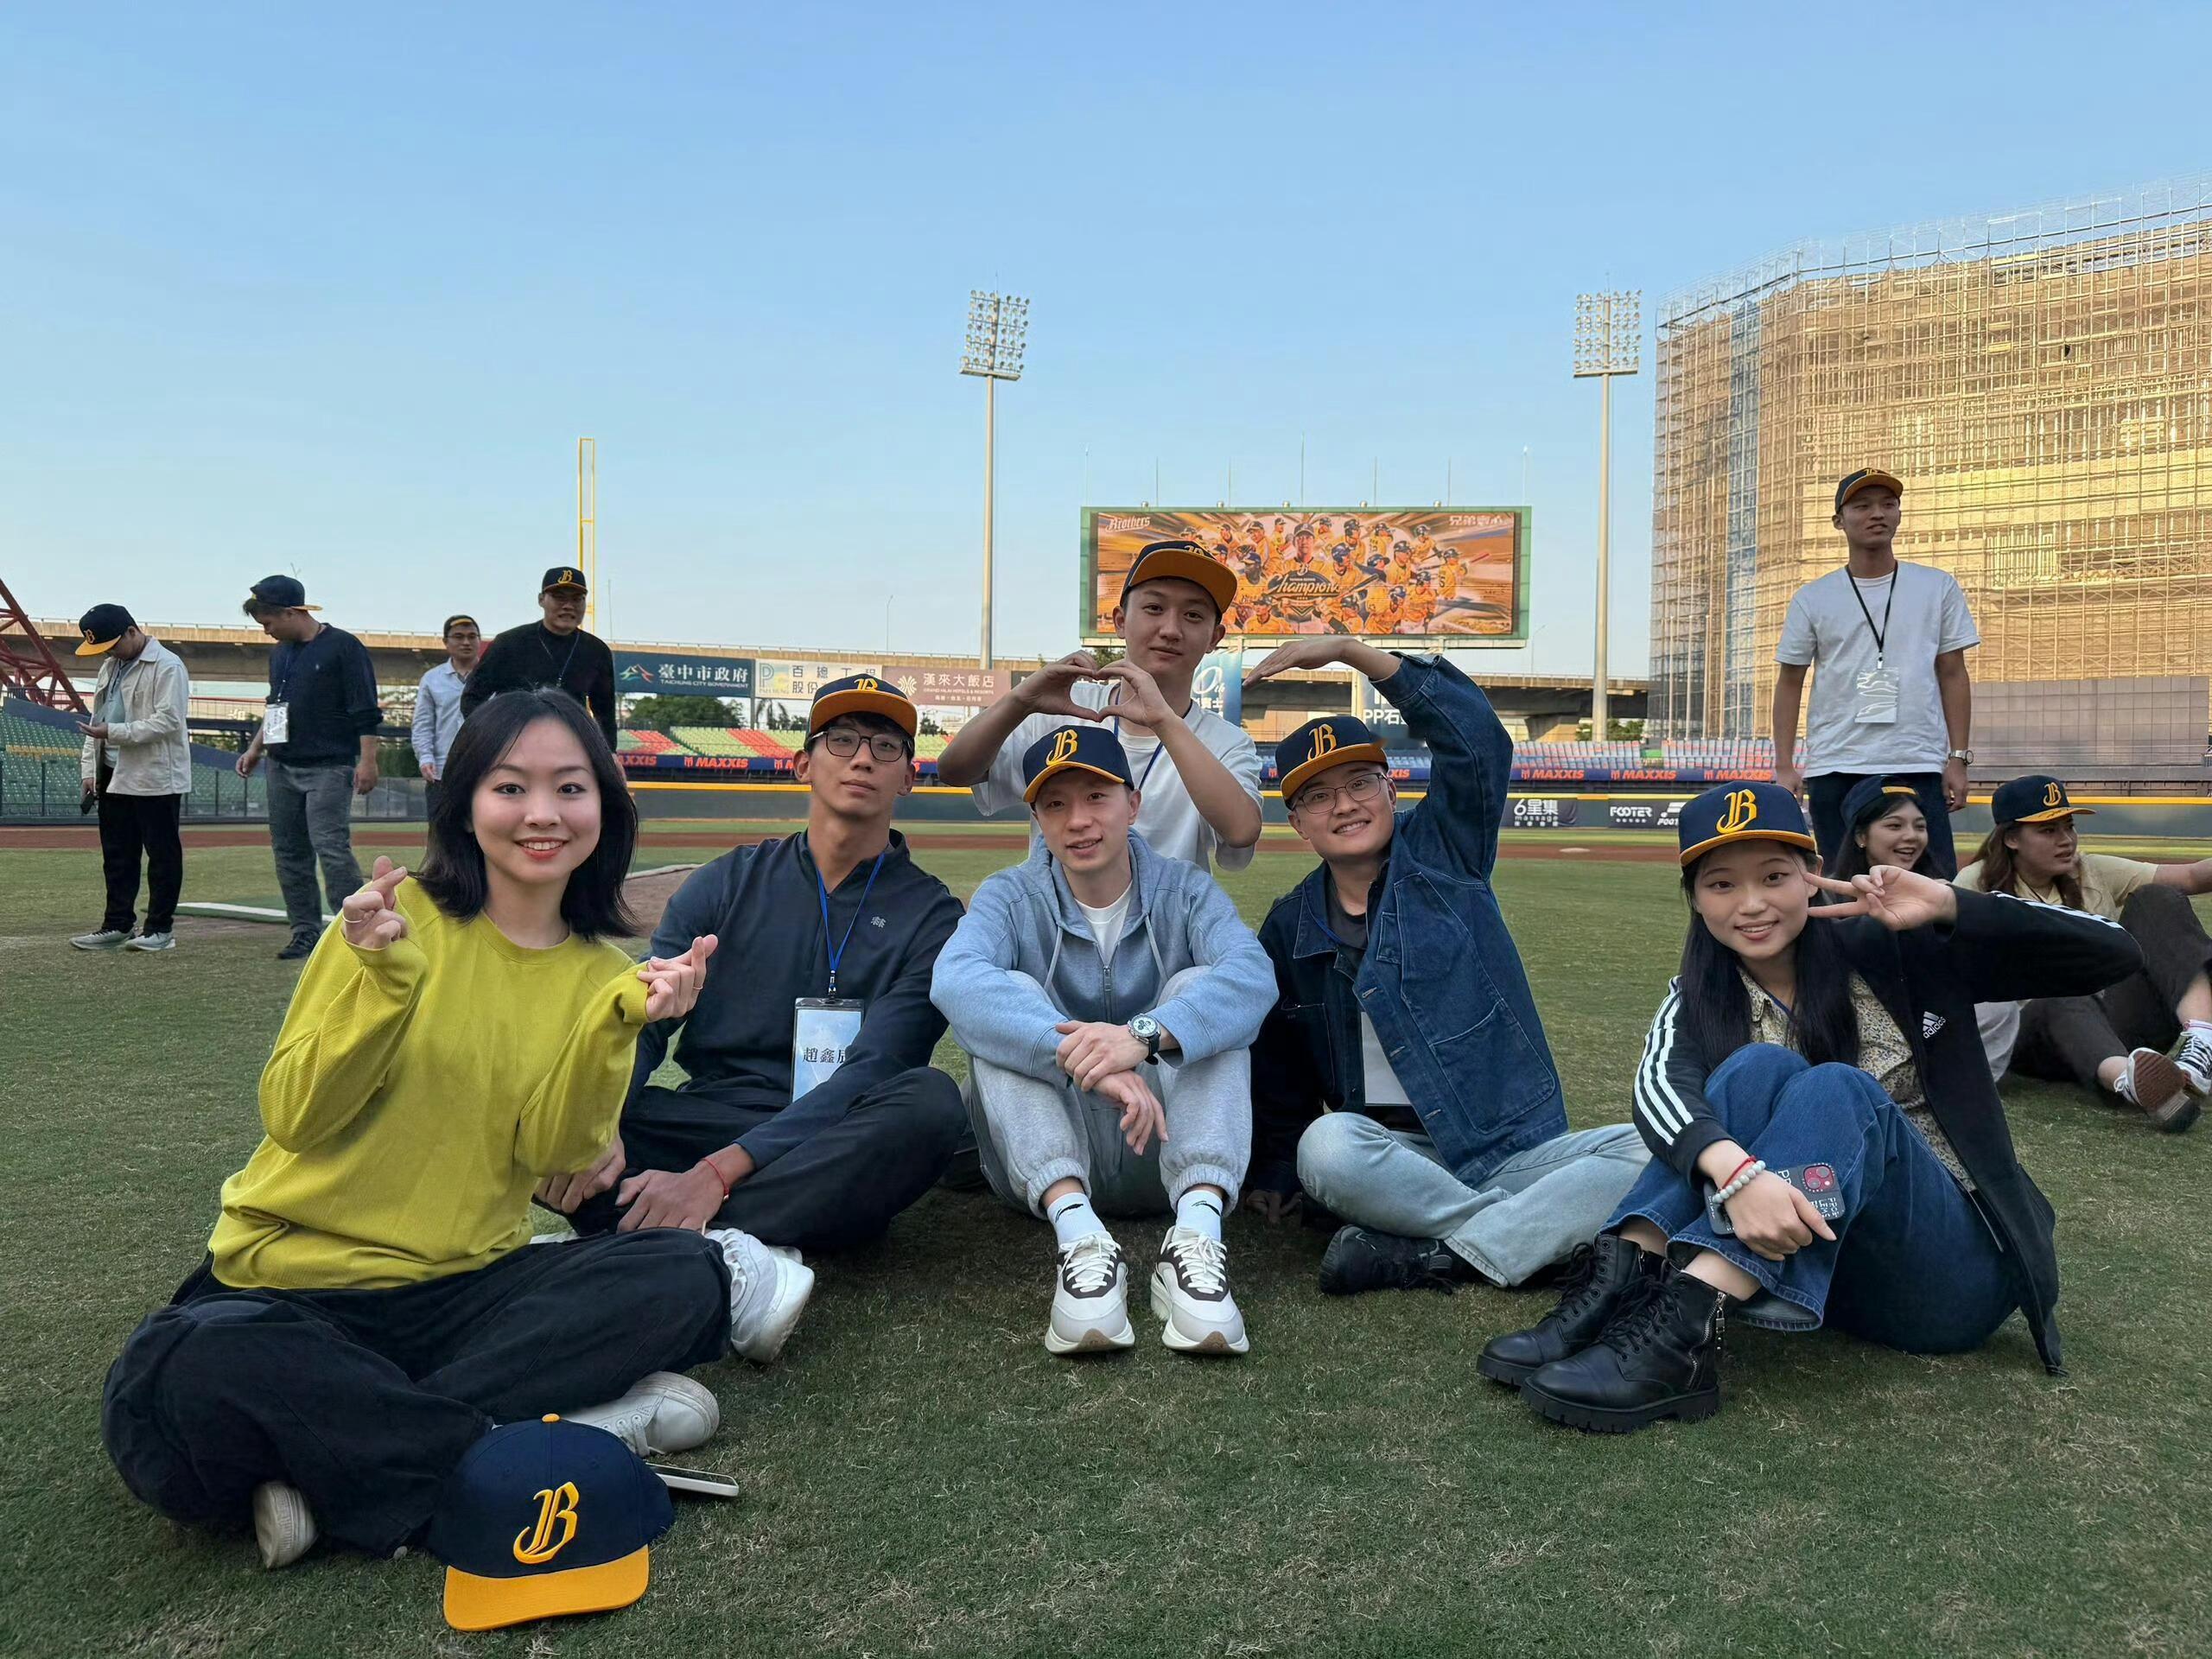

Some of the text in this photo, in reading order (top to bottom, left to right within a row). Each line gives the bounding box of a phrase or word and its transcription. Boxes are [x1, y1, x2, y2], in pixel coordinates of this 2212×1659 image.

[658, 663, 748, 683] 臺中市政府
[923, 672, 994, 688] 漢來大飯店
[1046, 728, 1078, 766] B
[1307, 723, 1337, 761] B
[617, 753, 657, 766] AXXIS
[696, 757, 749, 769] MAXXIS
[1389, 768, 1410, 779] XIS
[1532, 769, 1585, 780] MAXXIS
[1622, 769, 1677, 780] MAXXIS
[1716, 769, 1772, 781] MAXXIS
[2043, 782, 2062, 806] B
[1513, 798, 1559, 816] 6星集
[1610, 806, 1652, 817] FOOTER
[1716, 788, 1758, 834] B
[1923, 1016, 1946, 1039] adidas
[512, 1481, 580, 1565] B
